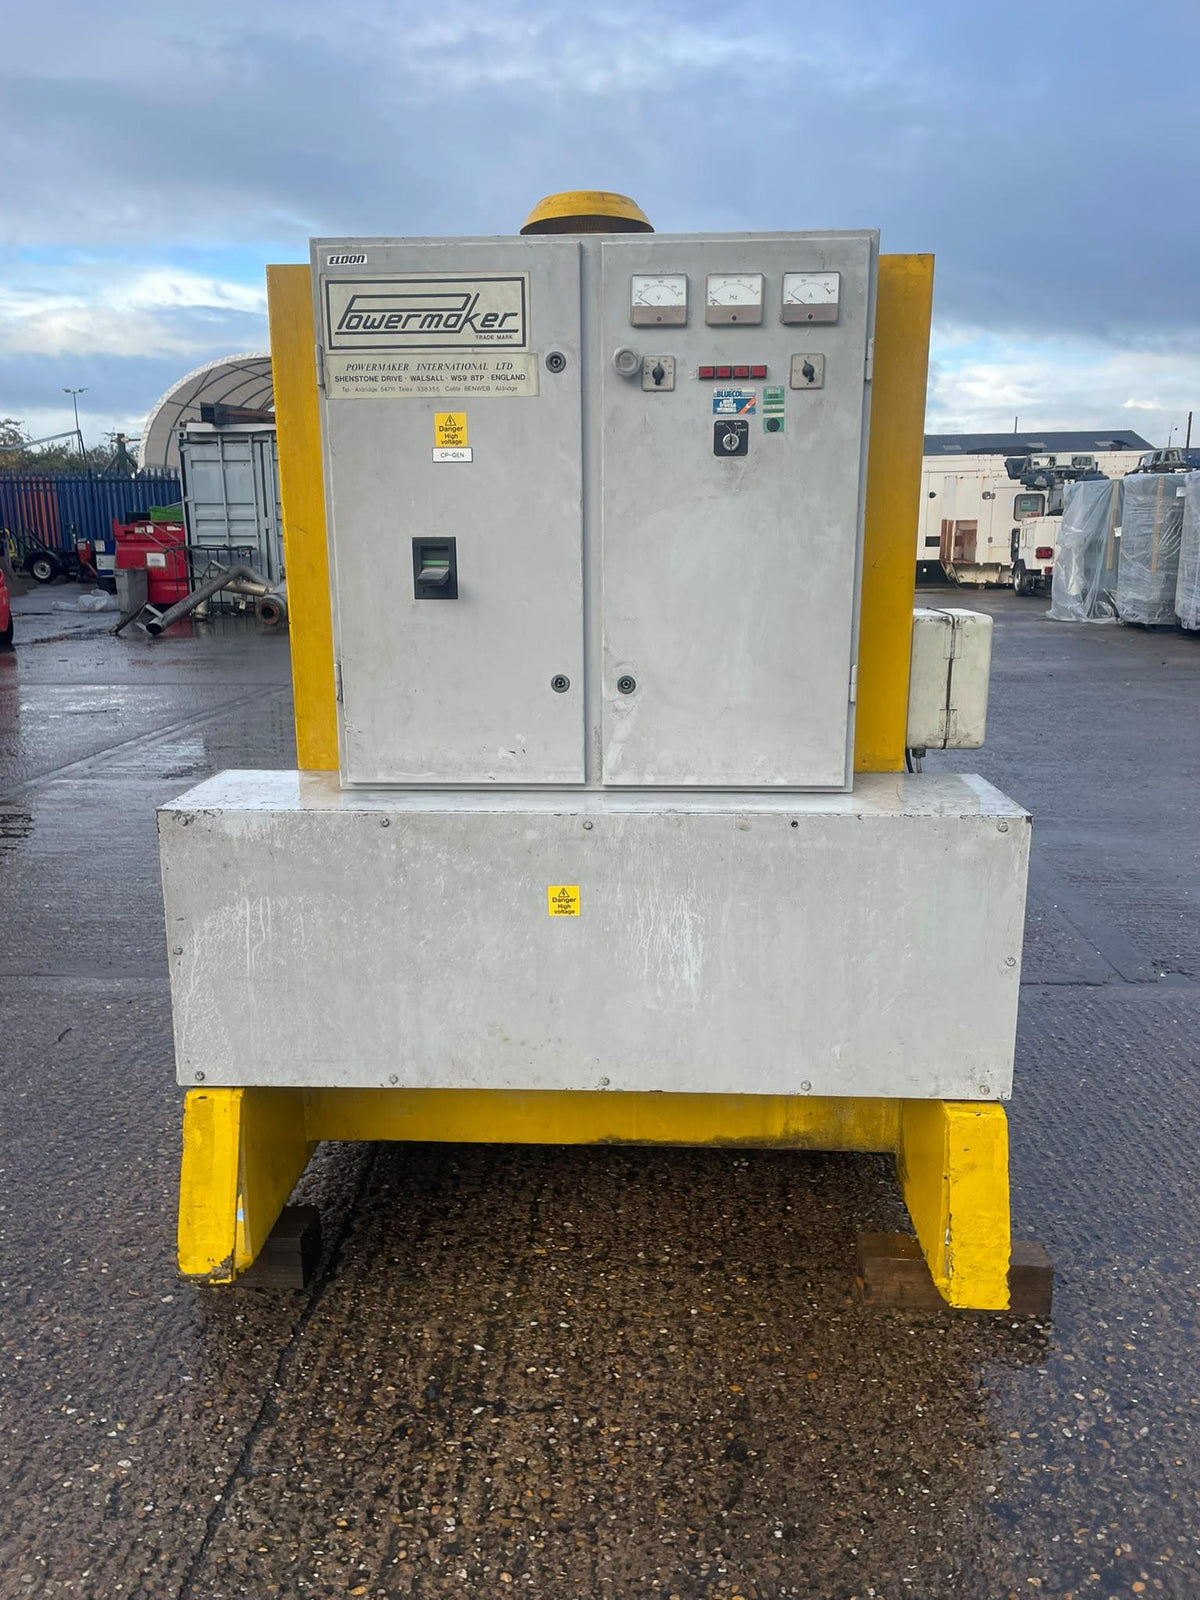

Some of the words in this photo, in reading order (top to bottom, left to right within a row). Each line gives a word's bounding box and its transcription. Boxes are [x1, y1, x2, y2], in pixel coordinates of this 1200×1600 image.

[329, 255, 365, 264] ELDON
[336, 292, 519, 333] Powermaker
[345, 362, 409, 371] POWERMAKER
[416, 362, 488, 371] INTERNATIONAL
[495, 362, 513, 370] LTD
[410, 374, 444, 382] WALSALL
